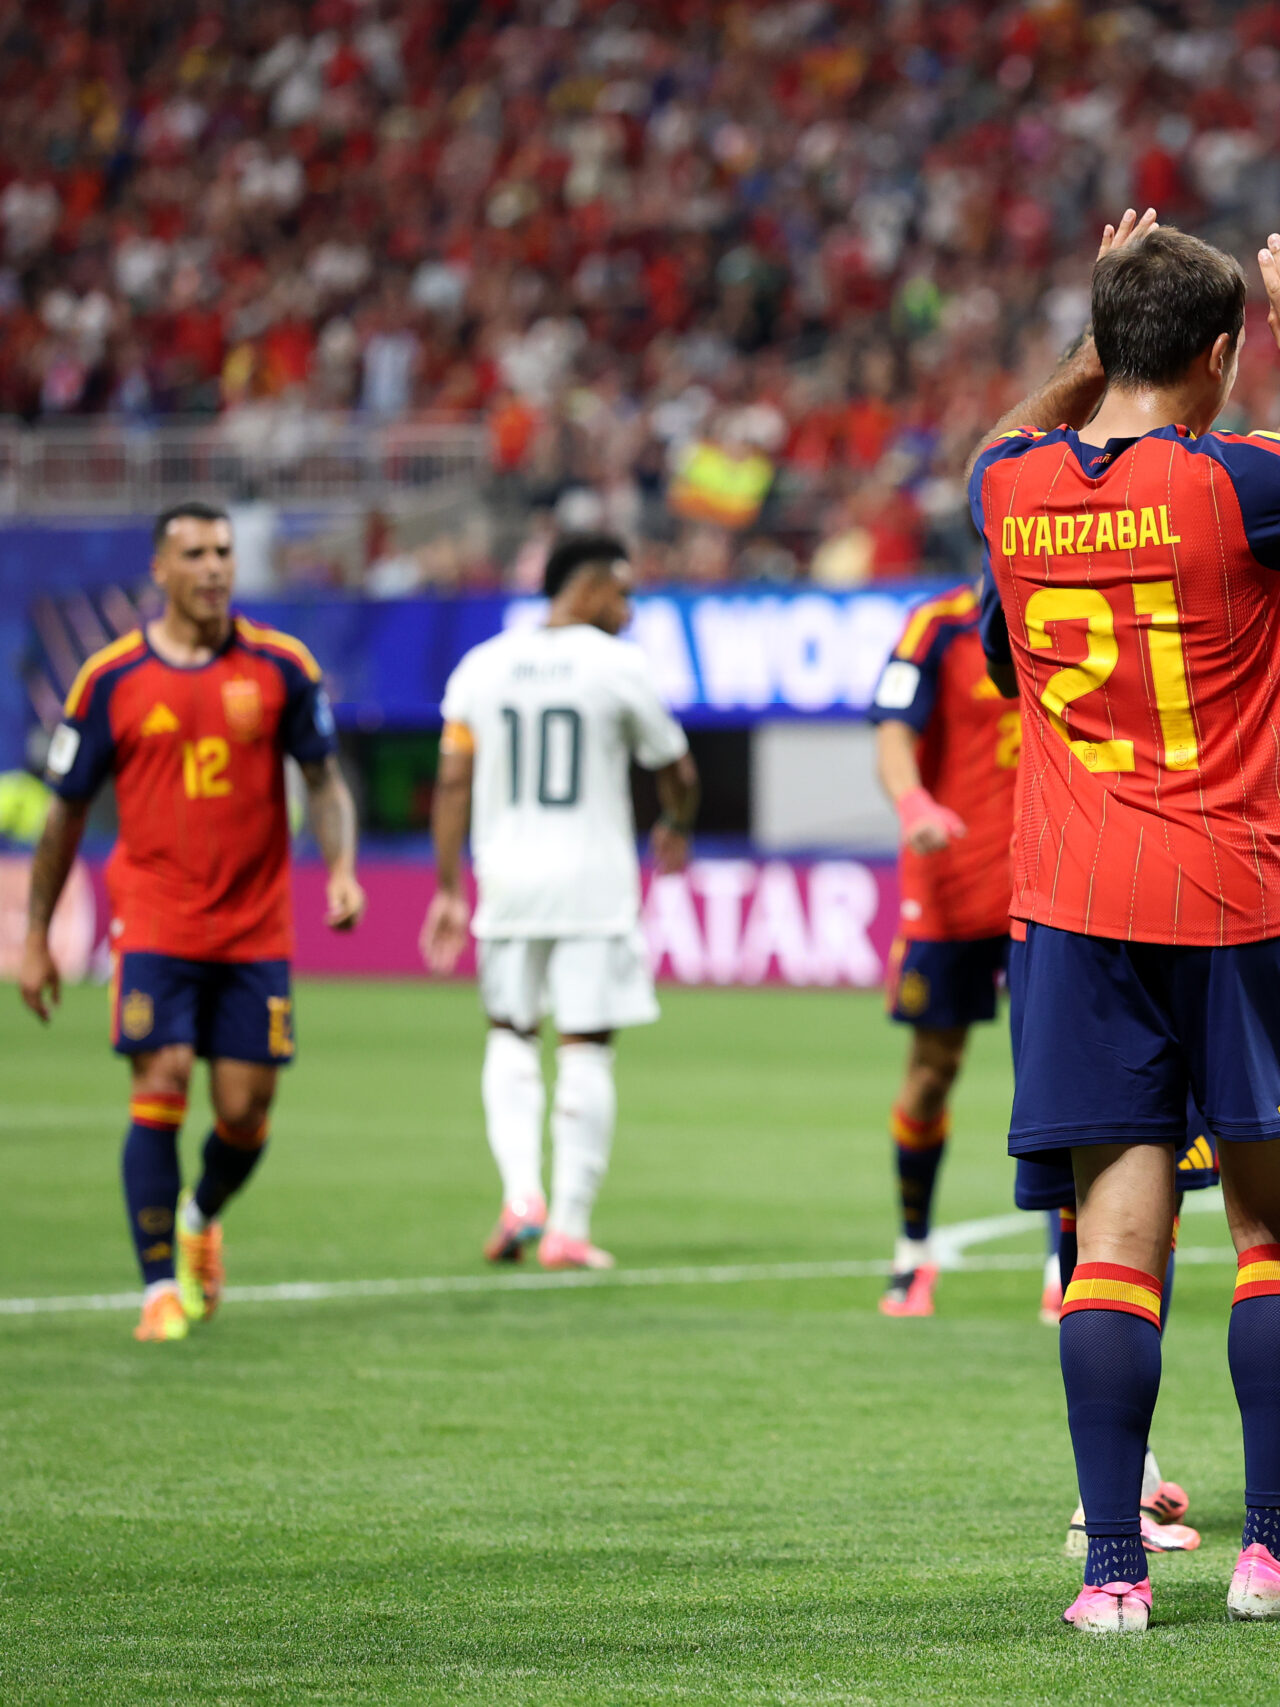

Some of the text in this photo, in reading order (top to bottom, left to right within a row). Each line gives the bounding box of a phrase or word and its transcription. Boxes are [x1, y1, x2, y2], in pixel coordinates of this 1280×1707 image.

[1002, 504, 1181, 556] OYARZABAL
[1025, 580, 1200, 773] 21
[183, 736, 232, 799] 12
[501, 706, 582, 807] 10
[640, 858, 883, 986] ATAR
